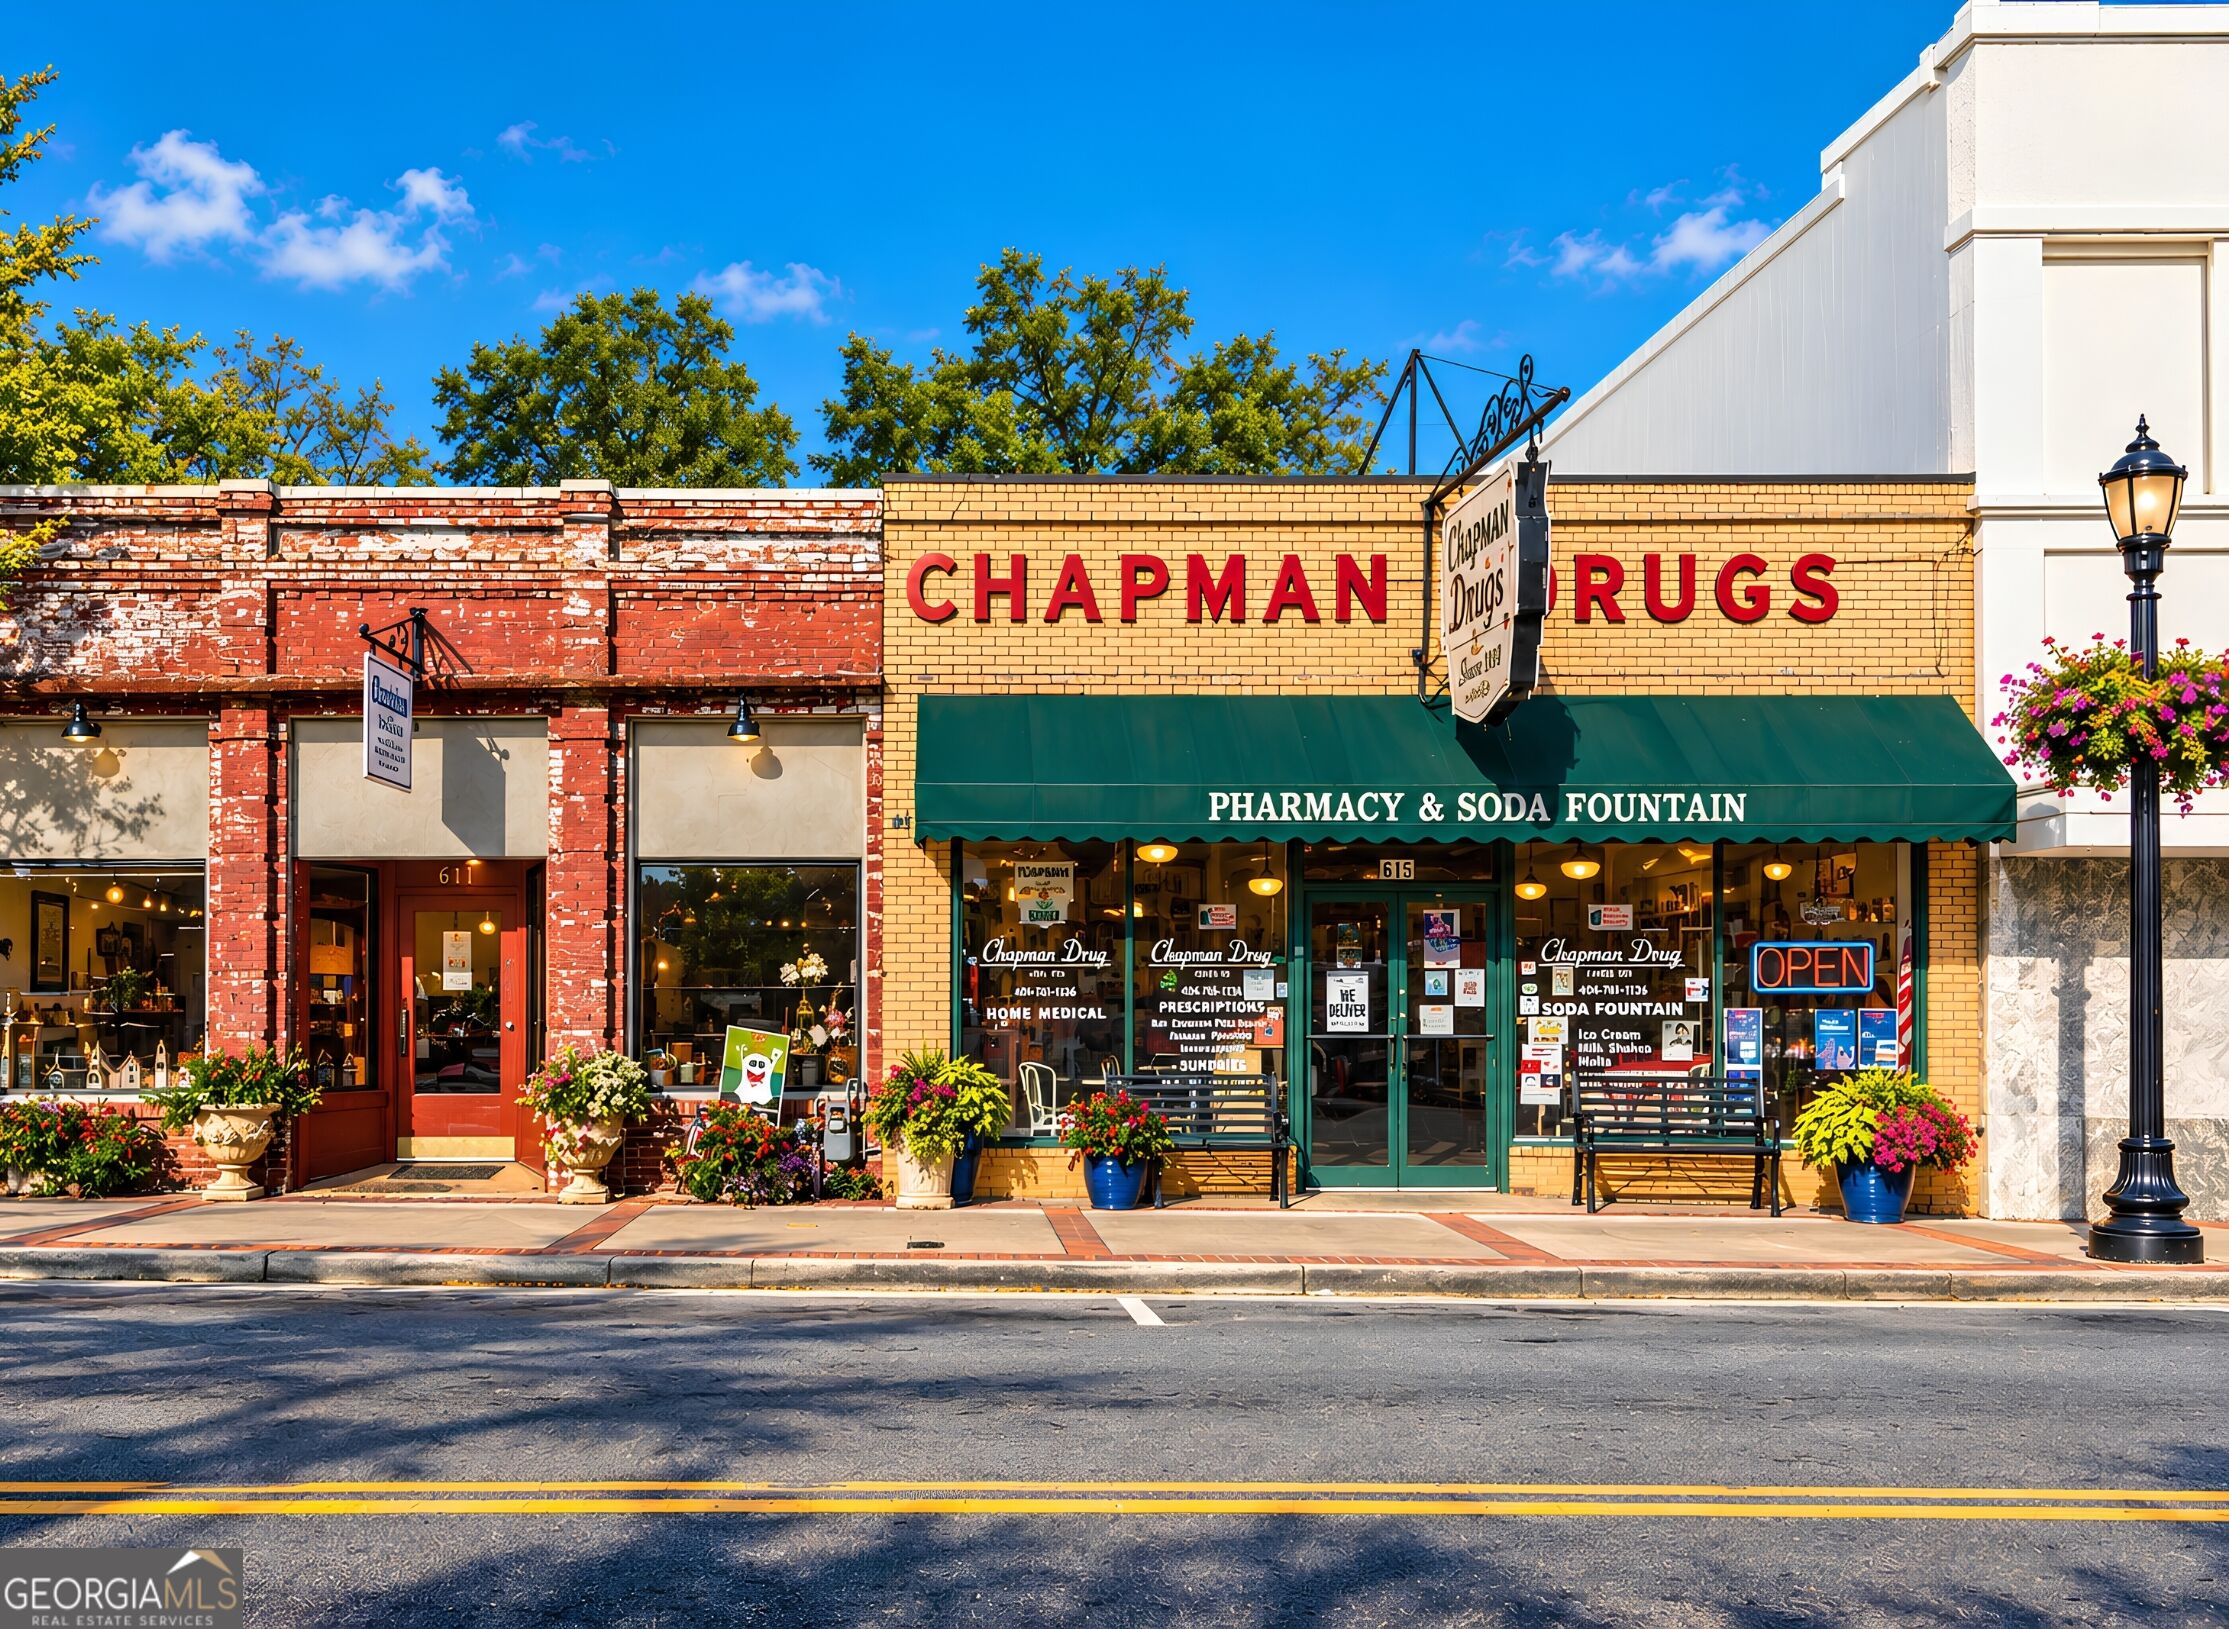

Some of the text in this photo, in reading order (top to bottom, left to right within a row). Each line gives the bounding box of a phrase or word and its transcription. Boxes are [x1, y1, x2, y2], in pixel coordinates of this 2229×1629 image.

[907, 552, 1840, 624] CHAPMAN RUGS
[1208, 791, 1748, 823] PHARMACY & SODA FOUNTAIN
[439, 866, 473, 885] 611
[1382, 861, 1412, 879] 615
[982, 935, 1108, 971] Chapman Drug
[1151, 938, 1272, 970] Chapman Drug
[1541, 938, 1624, 968] Chapman
[1757, 947, 1869, 988] OPEN
[986, 1007, 1107, 1020] HOME MEDICAL
[1541, 1002, 1684, 1016] SODA FOUNTAIN
